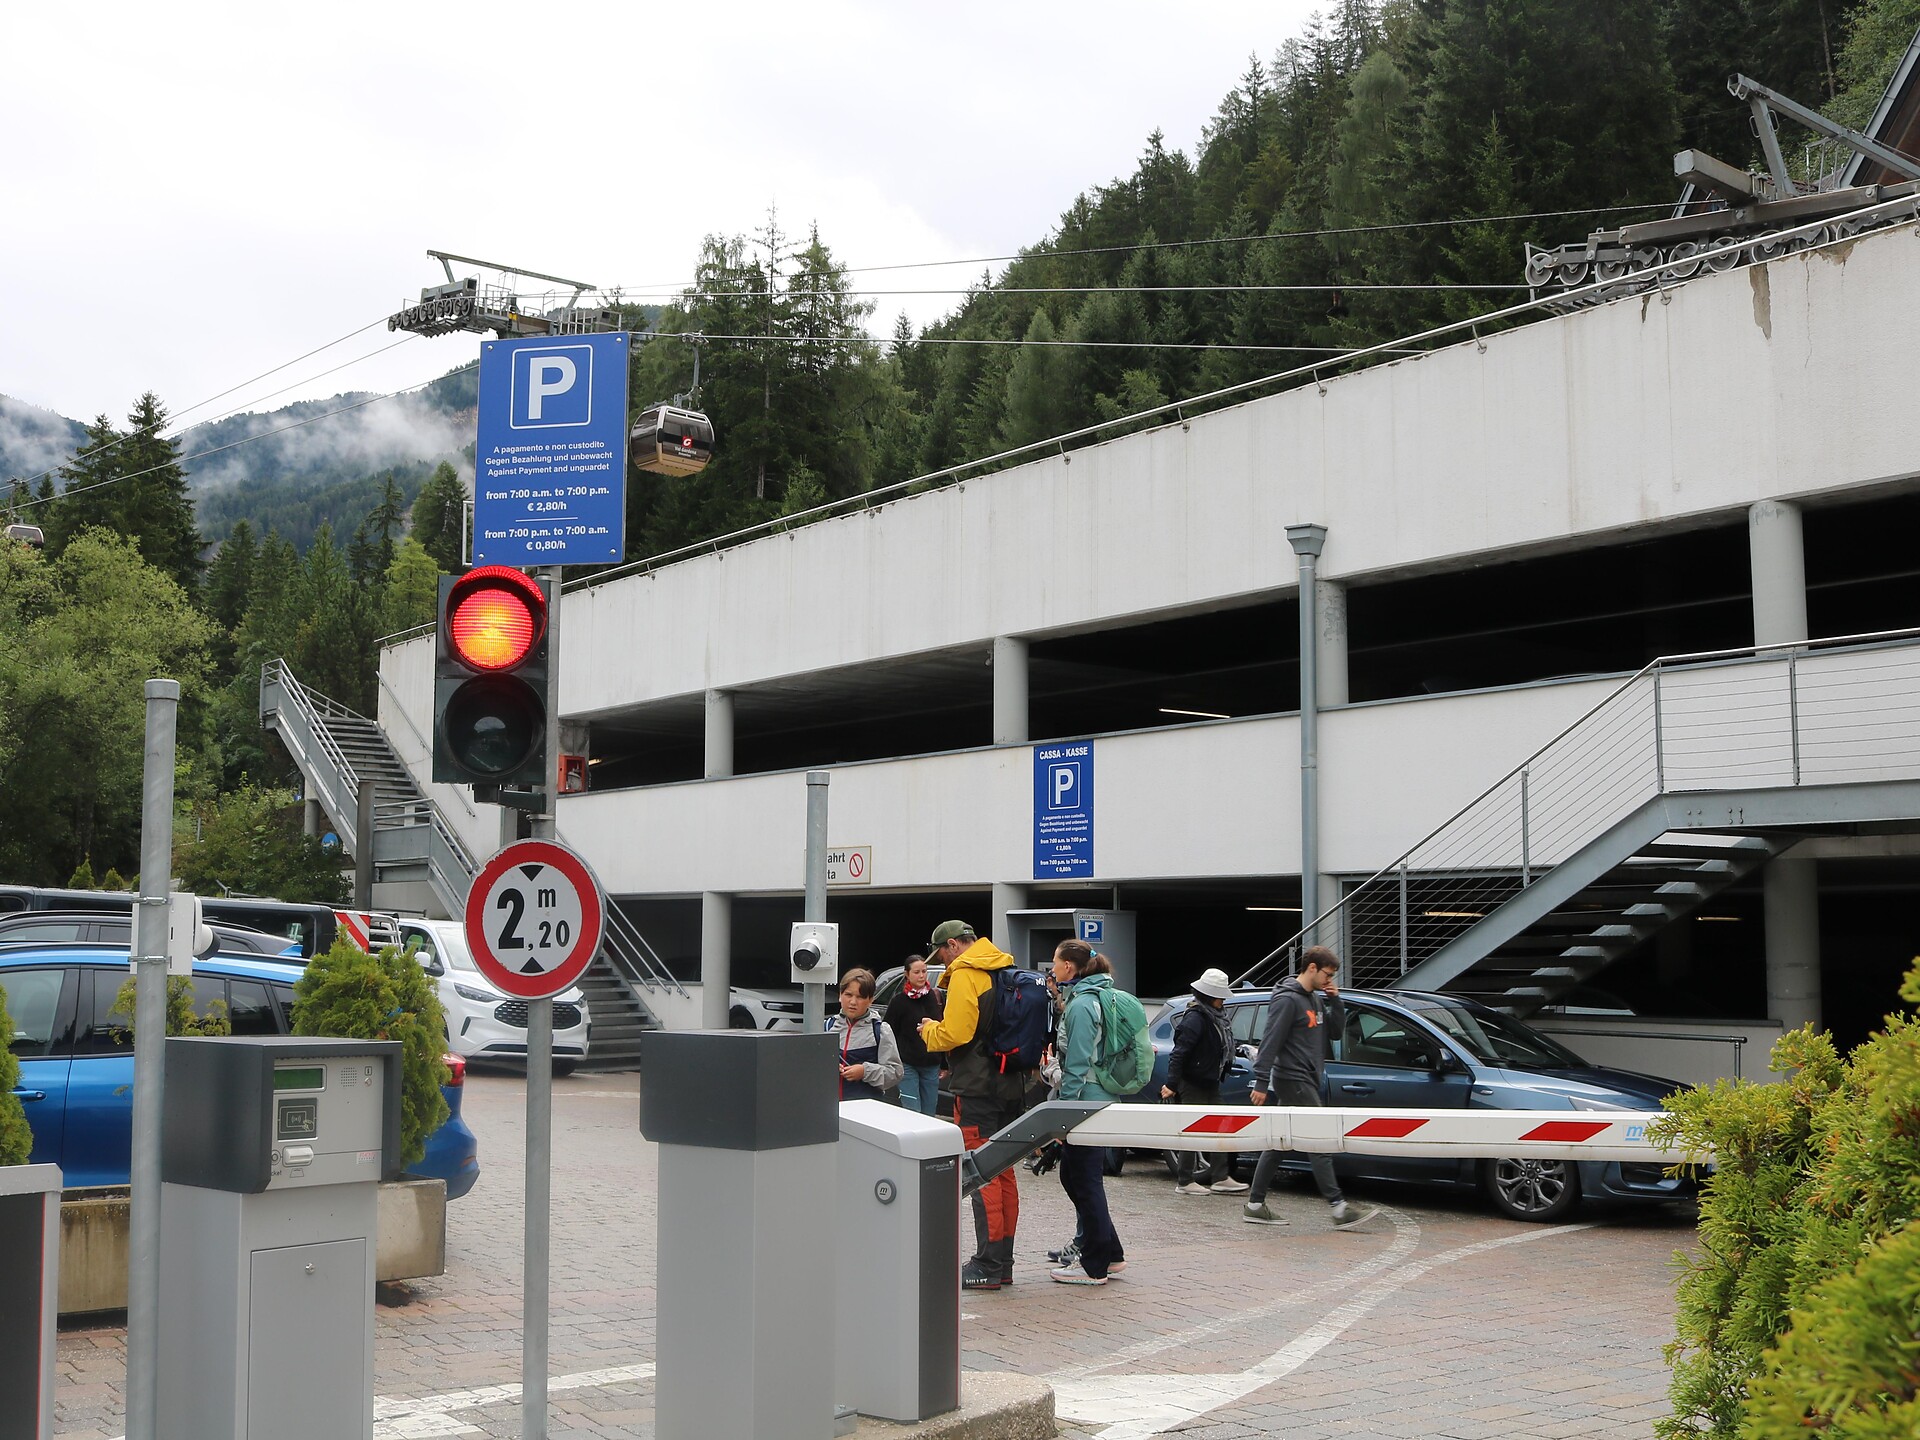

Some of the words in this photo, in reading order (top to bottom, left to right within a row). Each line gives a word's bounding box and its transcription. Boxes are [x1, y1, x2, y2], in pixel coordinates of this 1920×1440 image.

[528, 356, 576, 420] P
[501, 445, 543, 454] pagamento
[568, 441, 605, 449] custodito
[485, 458, 510, 466] Gegen
[512, 455, 552, 464] Bezahlung
[570, 452, 612, 460] unbewacht
[488, 468, 517, 477] Against
[519, 466, 552, 475] Payment
[570, 463, 609, 472] unguardet
[486, 491, 507, 500] from
[510, 489, 530, 498] 7:00
[554, 488, 564, 496] to
[567, 486, 587, 496] 7:00
[589, 488, 609, 496] p.m.
[527, 503, 534, 511] €
[536, 502, 567, 512] 2,80/h
[484, 530, 506, 538] from
[509, 529, 528, 538] 7:00
[531, 530, 551, 538] p.m.
[554, 528, 563, 536] to
[566, 526, 586, 535] 7:00
[526, 542, 533, 550] €
[535, 540, 566, 552] 0,80/h
[1040, 750, 1061, 760] CASSA
[1066, 747, 1088, 757] KASSE
[1056, 769, 1074, 804] P
[827, 852, 845, 863] ahrt
[827, 869, 836, 880] ta
[538, 888, 556, 908] m
[1085, 922, 1098, 937] P
